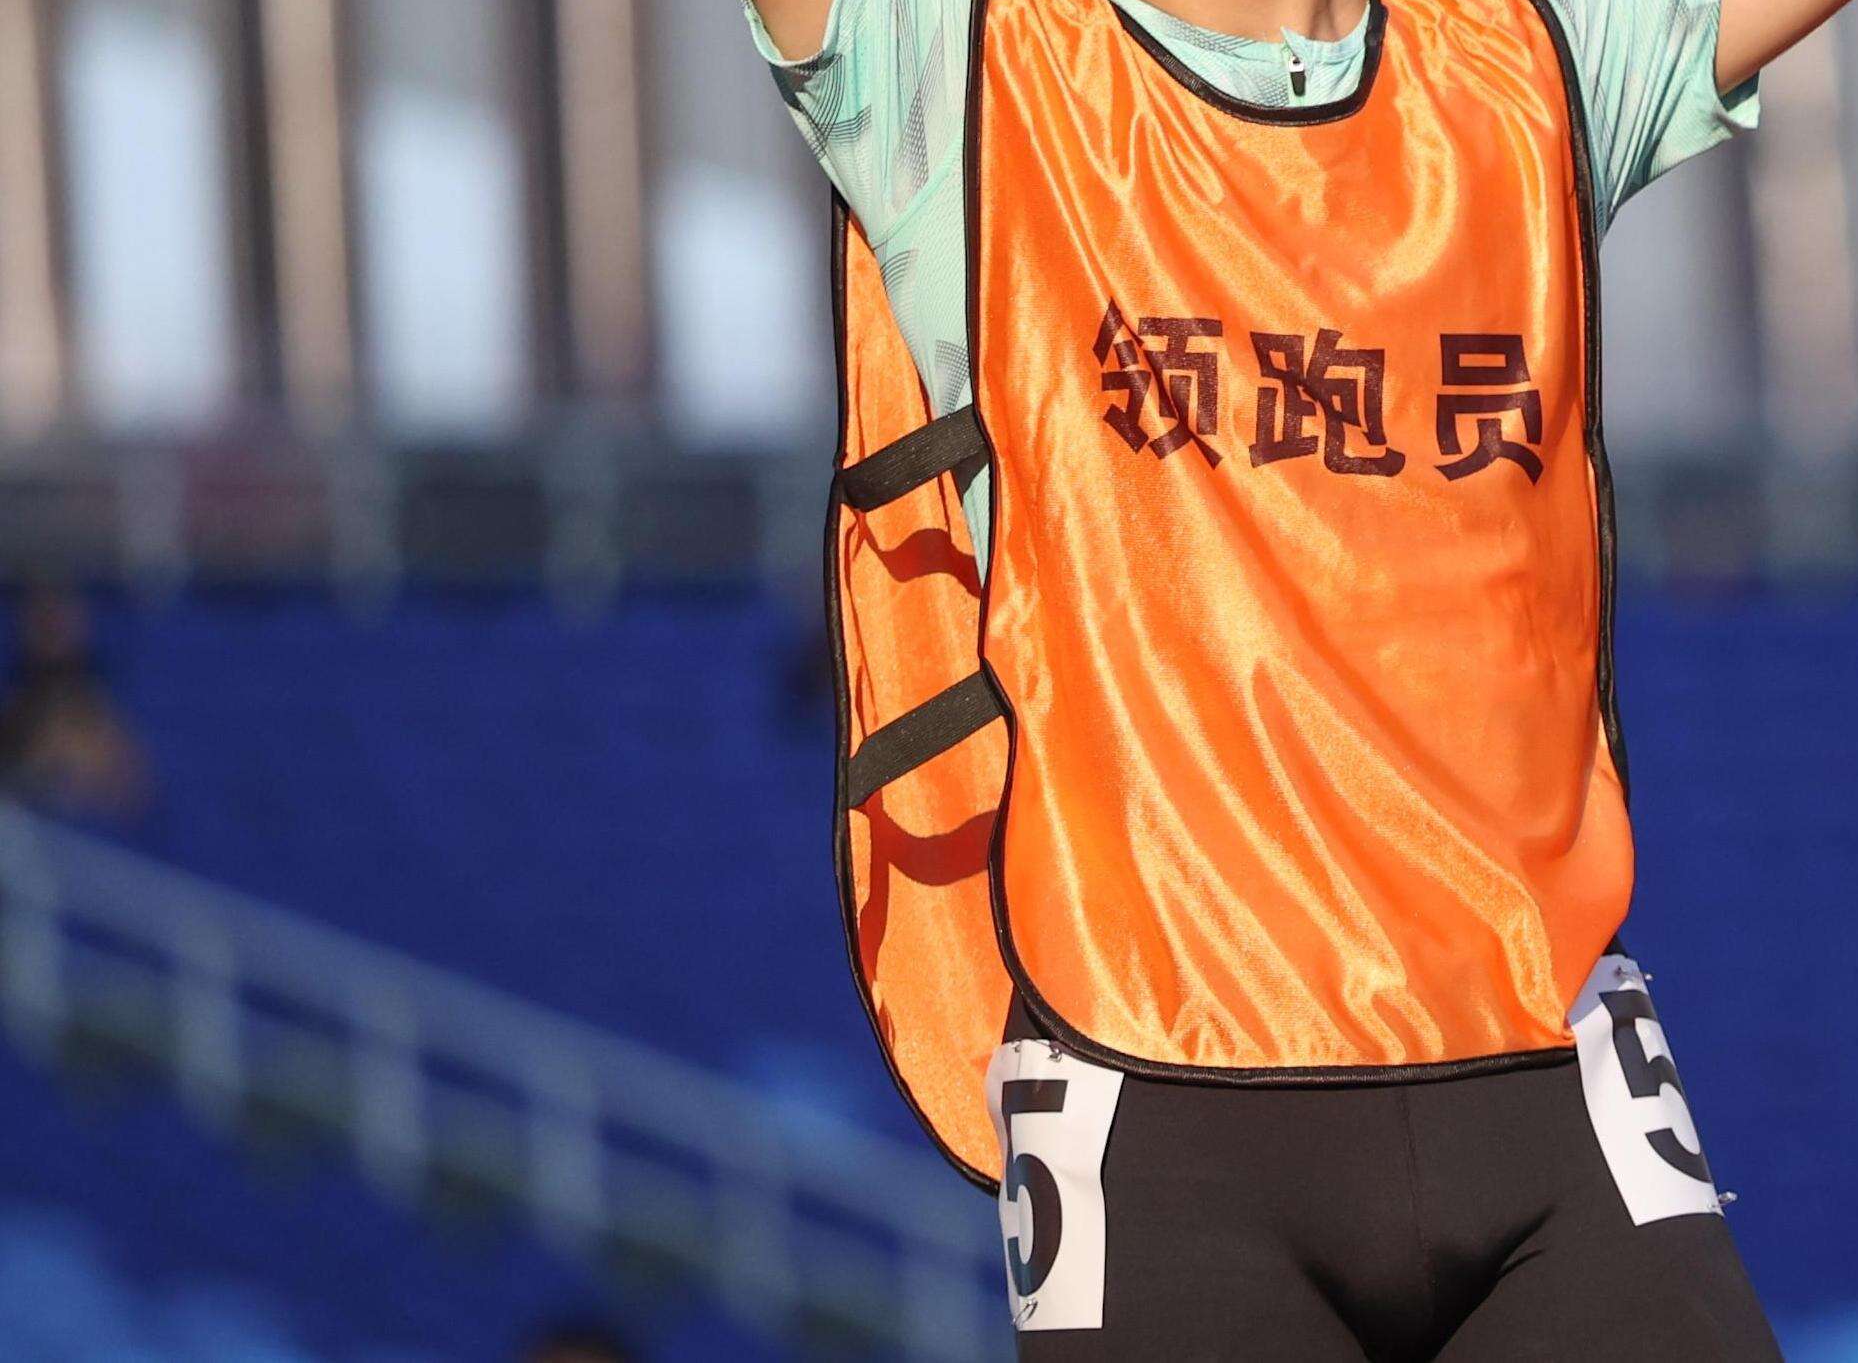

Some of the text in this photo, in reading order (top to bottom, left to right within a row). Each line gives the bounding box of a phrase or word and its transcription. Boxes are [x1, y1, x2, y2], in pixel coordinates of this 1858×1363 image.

[1092, 296, 1544, 486] 领跑员
[1600, 990, 1713, 1183] 5
[1001, 1078, 1068, 1297] 5
